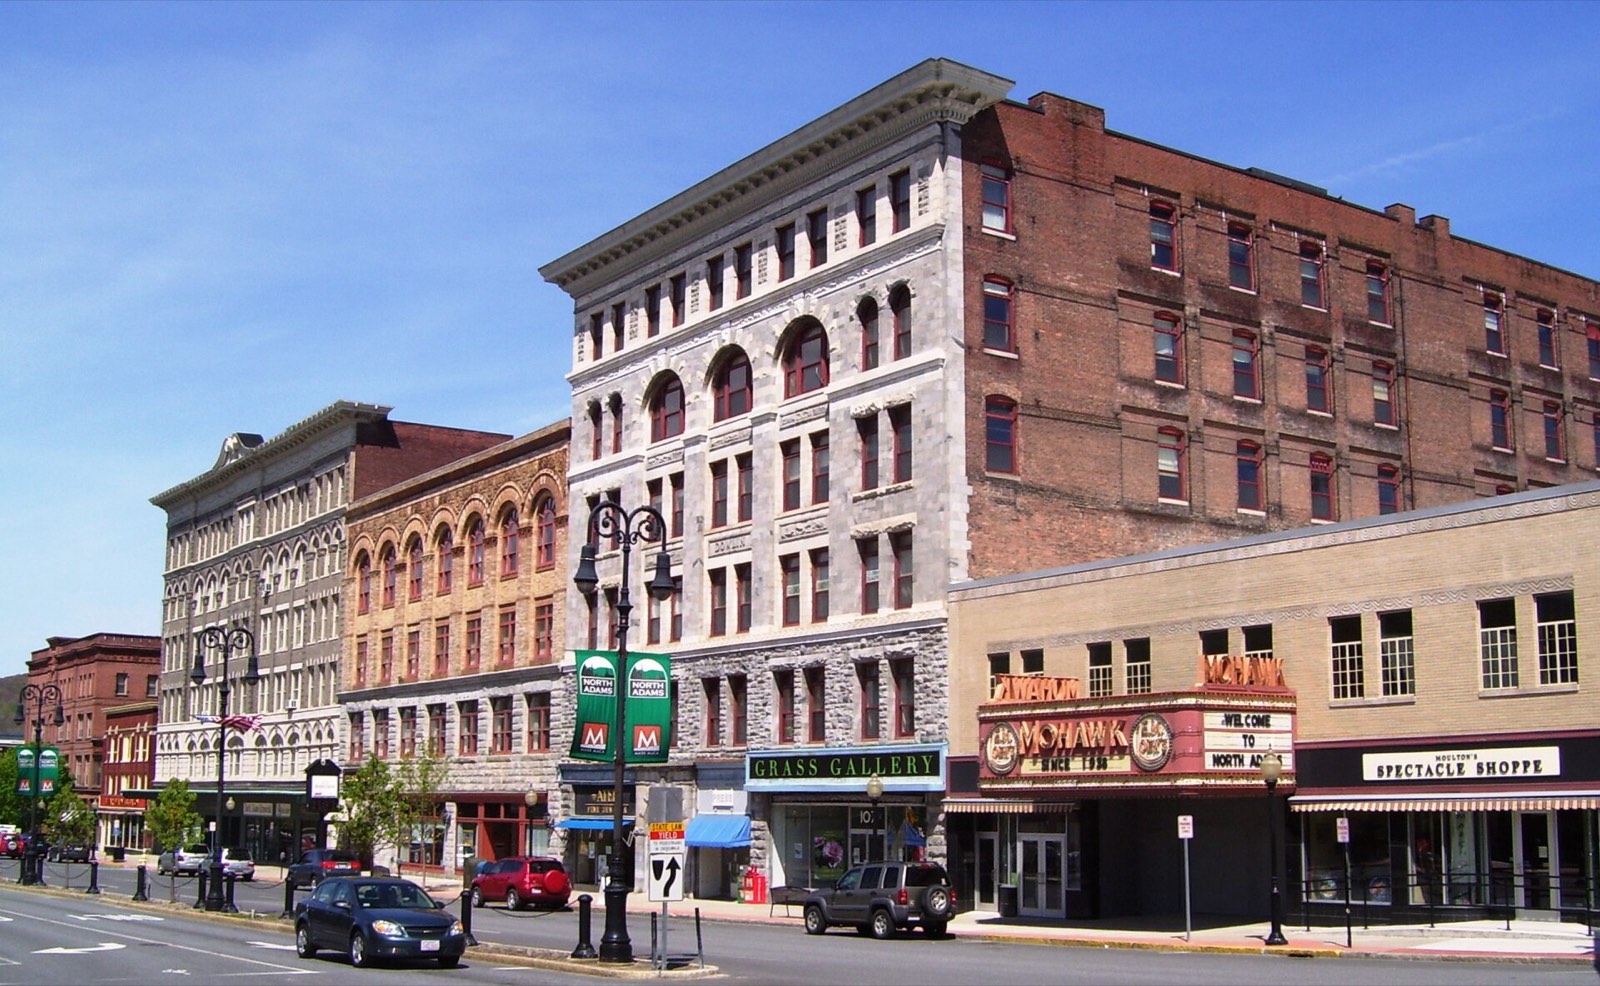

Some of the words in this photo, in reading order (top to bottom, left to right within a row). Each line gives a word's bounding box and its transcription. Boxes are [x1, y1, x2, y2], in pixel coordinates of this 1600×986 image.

[1197, 655, 1286, 687] MOHAWK
[583, 678, 613, 688] NORTH
[583, 686, 613, 695] ADAMS
[632, 681, 664, 689] NORTH
[632, 688, 665, 697] ADAMS
[1224, 713, 1271, 728] WELCOME
[584, 727, 605, 745] M
[637, 730, 657, 748] M
[1019, 719, 1129, 755] MOHAWK
[1242, 734, 1255, 748] TO
[1041, 757, 1071, 772] SINCE
[1212, 753, 1244, 768] NORTH
[1435, 753, 1478, 761] MOULTON'S
[755, 759, 818, 777] GRASS
[830, 755, 933, 776] GALLERY
[1377, 763, 1465, 778] SPECTACLE
[1476, 760, 1543, 776] SHOPPE
[652, 823, 668, 831] STATE
[658, 831, 678, 839] YIELD
